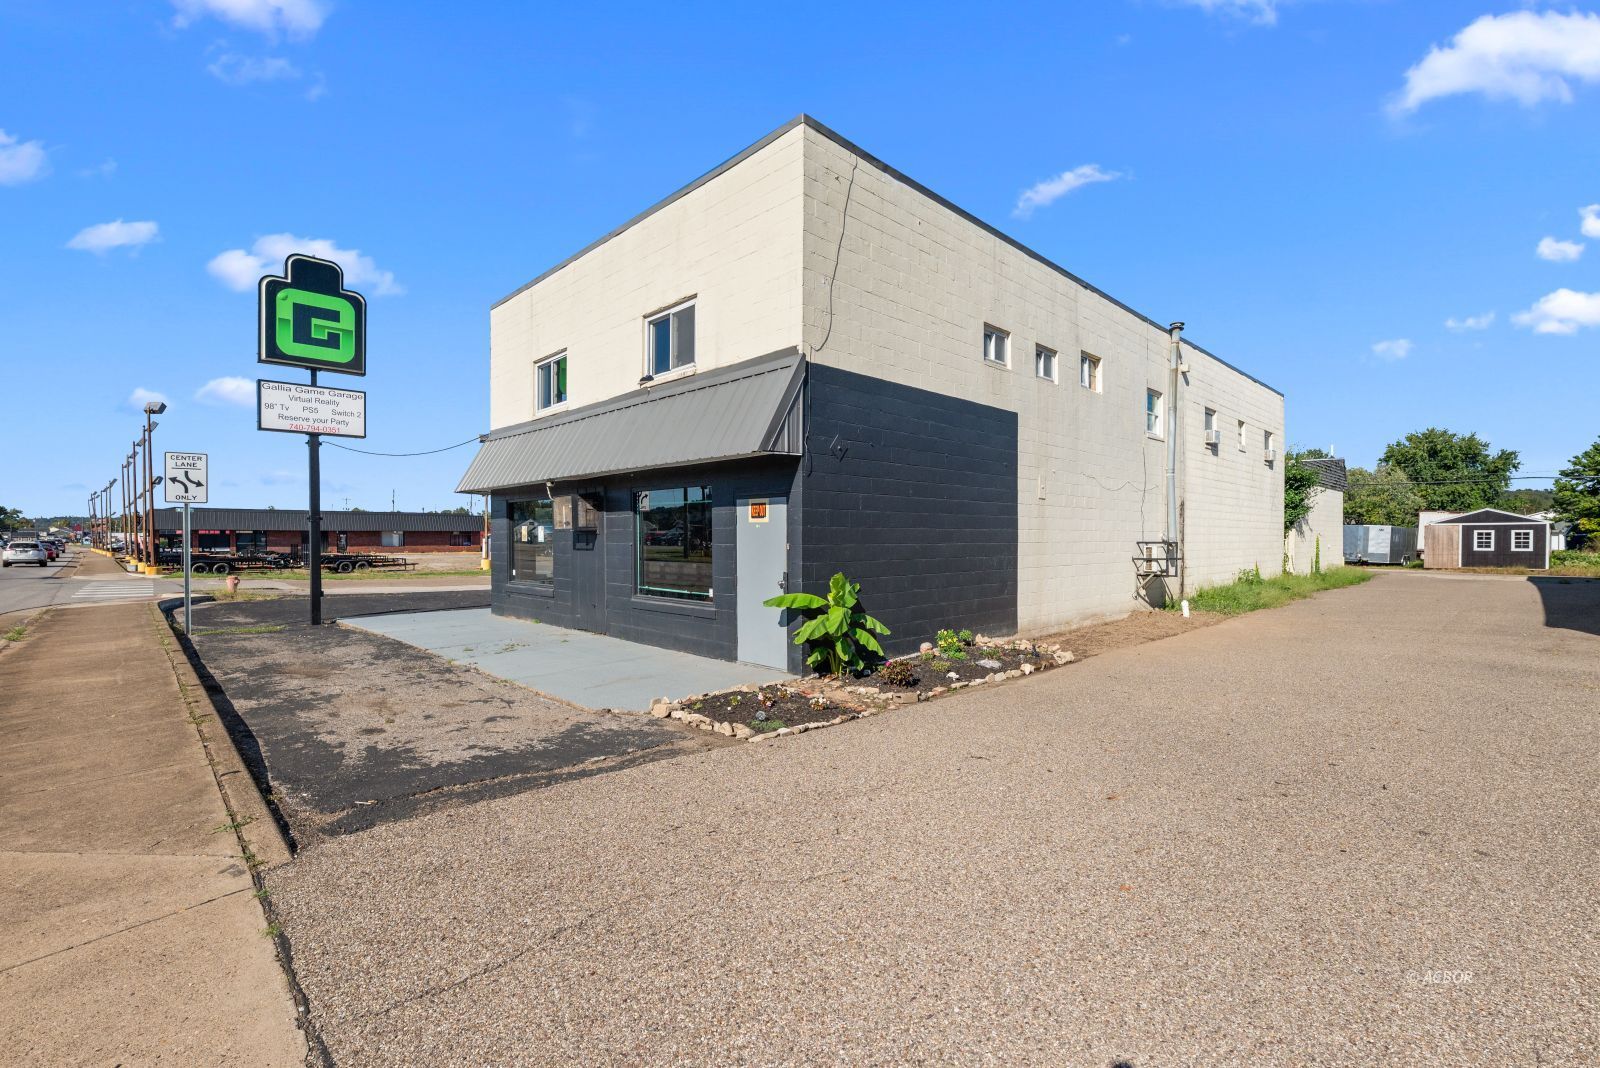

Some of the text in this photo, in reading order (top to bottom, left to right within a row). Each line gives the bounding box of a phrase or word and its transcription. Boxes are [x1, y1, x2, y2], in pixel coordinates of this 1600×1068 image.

[261, 382, 363, 400] Gallia Game Garage
[288, 394, 340, 407] Virtual Reality
[302, 406, 319, 414] PS5
[331, 409, 355, 417] Switch
[278, 413, 311, 423] Reserve
[330, 418, 350, 427] Party
[289, 423, 341, 433] 740-794-0351
